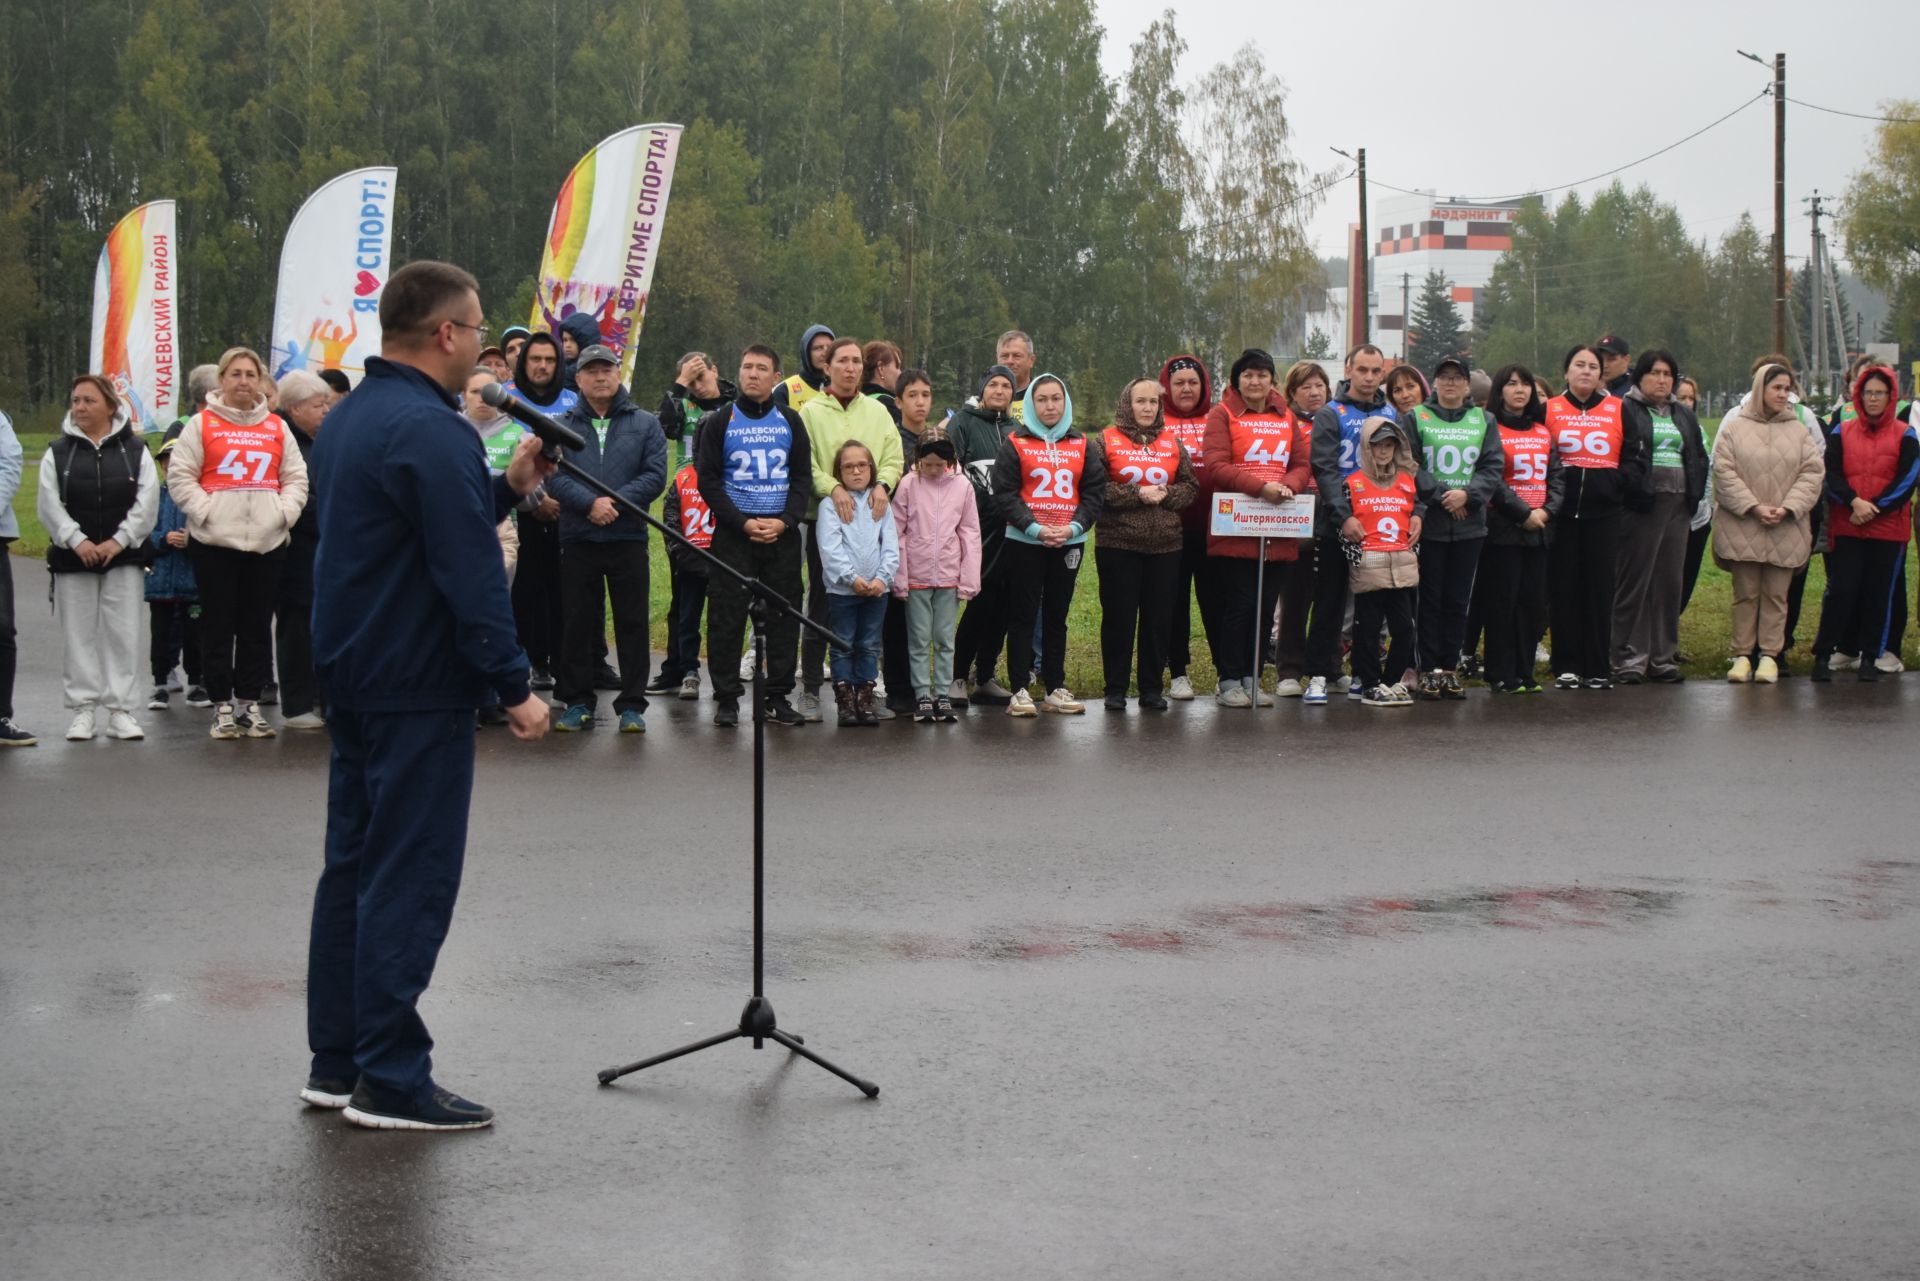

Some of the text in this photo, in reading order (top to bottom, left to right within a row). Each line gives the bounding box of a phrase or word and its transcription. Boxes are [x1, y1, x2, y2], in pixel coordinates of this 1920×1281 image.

[637, 129, 669, 217] СПОРТА!
[353, 179, 387, 313] Я СПОРТ!
[622, 221, 653, 292] РИТМЕ
[150, 234, 173, 409] ТУКАЕВСКИЙ РАЙОН
[728, 426, 788, 438] ТУКАЕВСКИЙ
[1239, 421, 1290, 429] ТУКАЕВСКИЙ
[1424, 426, 1480, 436] ТУКАЕВСКИЙ
[213, 431, 276, 442] ТУКАЕВСКИЙ
[227, 437, 263, 446] РАЙОН
[743, 436, 775, 445] РАЙОН
[1437, 433, 1469, 441] РАЙОН
[1557, 429, 1611, 456] 56
[730, 448, 788, 481] 212
[1128, 456, 1162, 464] РАЙОН
[1244, 439, 1290, 468] 44
[1423, 444, 1480, 475] 109
[217, 449, 273, 482] 47
[1120, 466, 1168, 485] 29
[1513, 453, 1548, 481] 55
[1030, 468, 1074, 499] 28
[1359, 497, 1409, 506] ТУКАЕВСКИЙ
[1373, 504, 1401, 513] РАЙОН
[1233, 511, 1310, 526] Иштеряковское
[1376, 517, 1400, 543] 9
